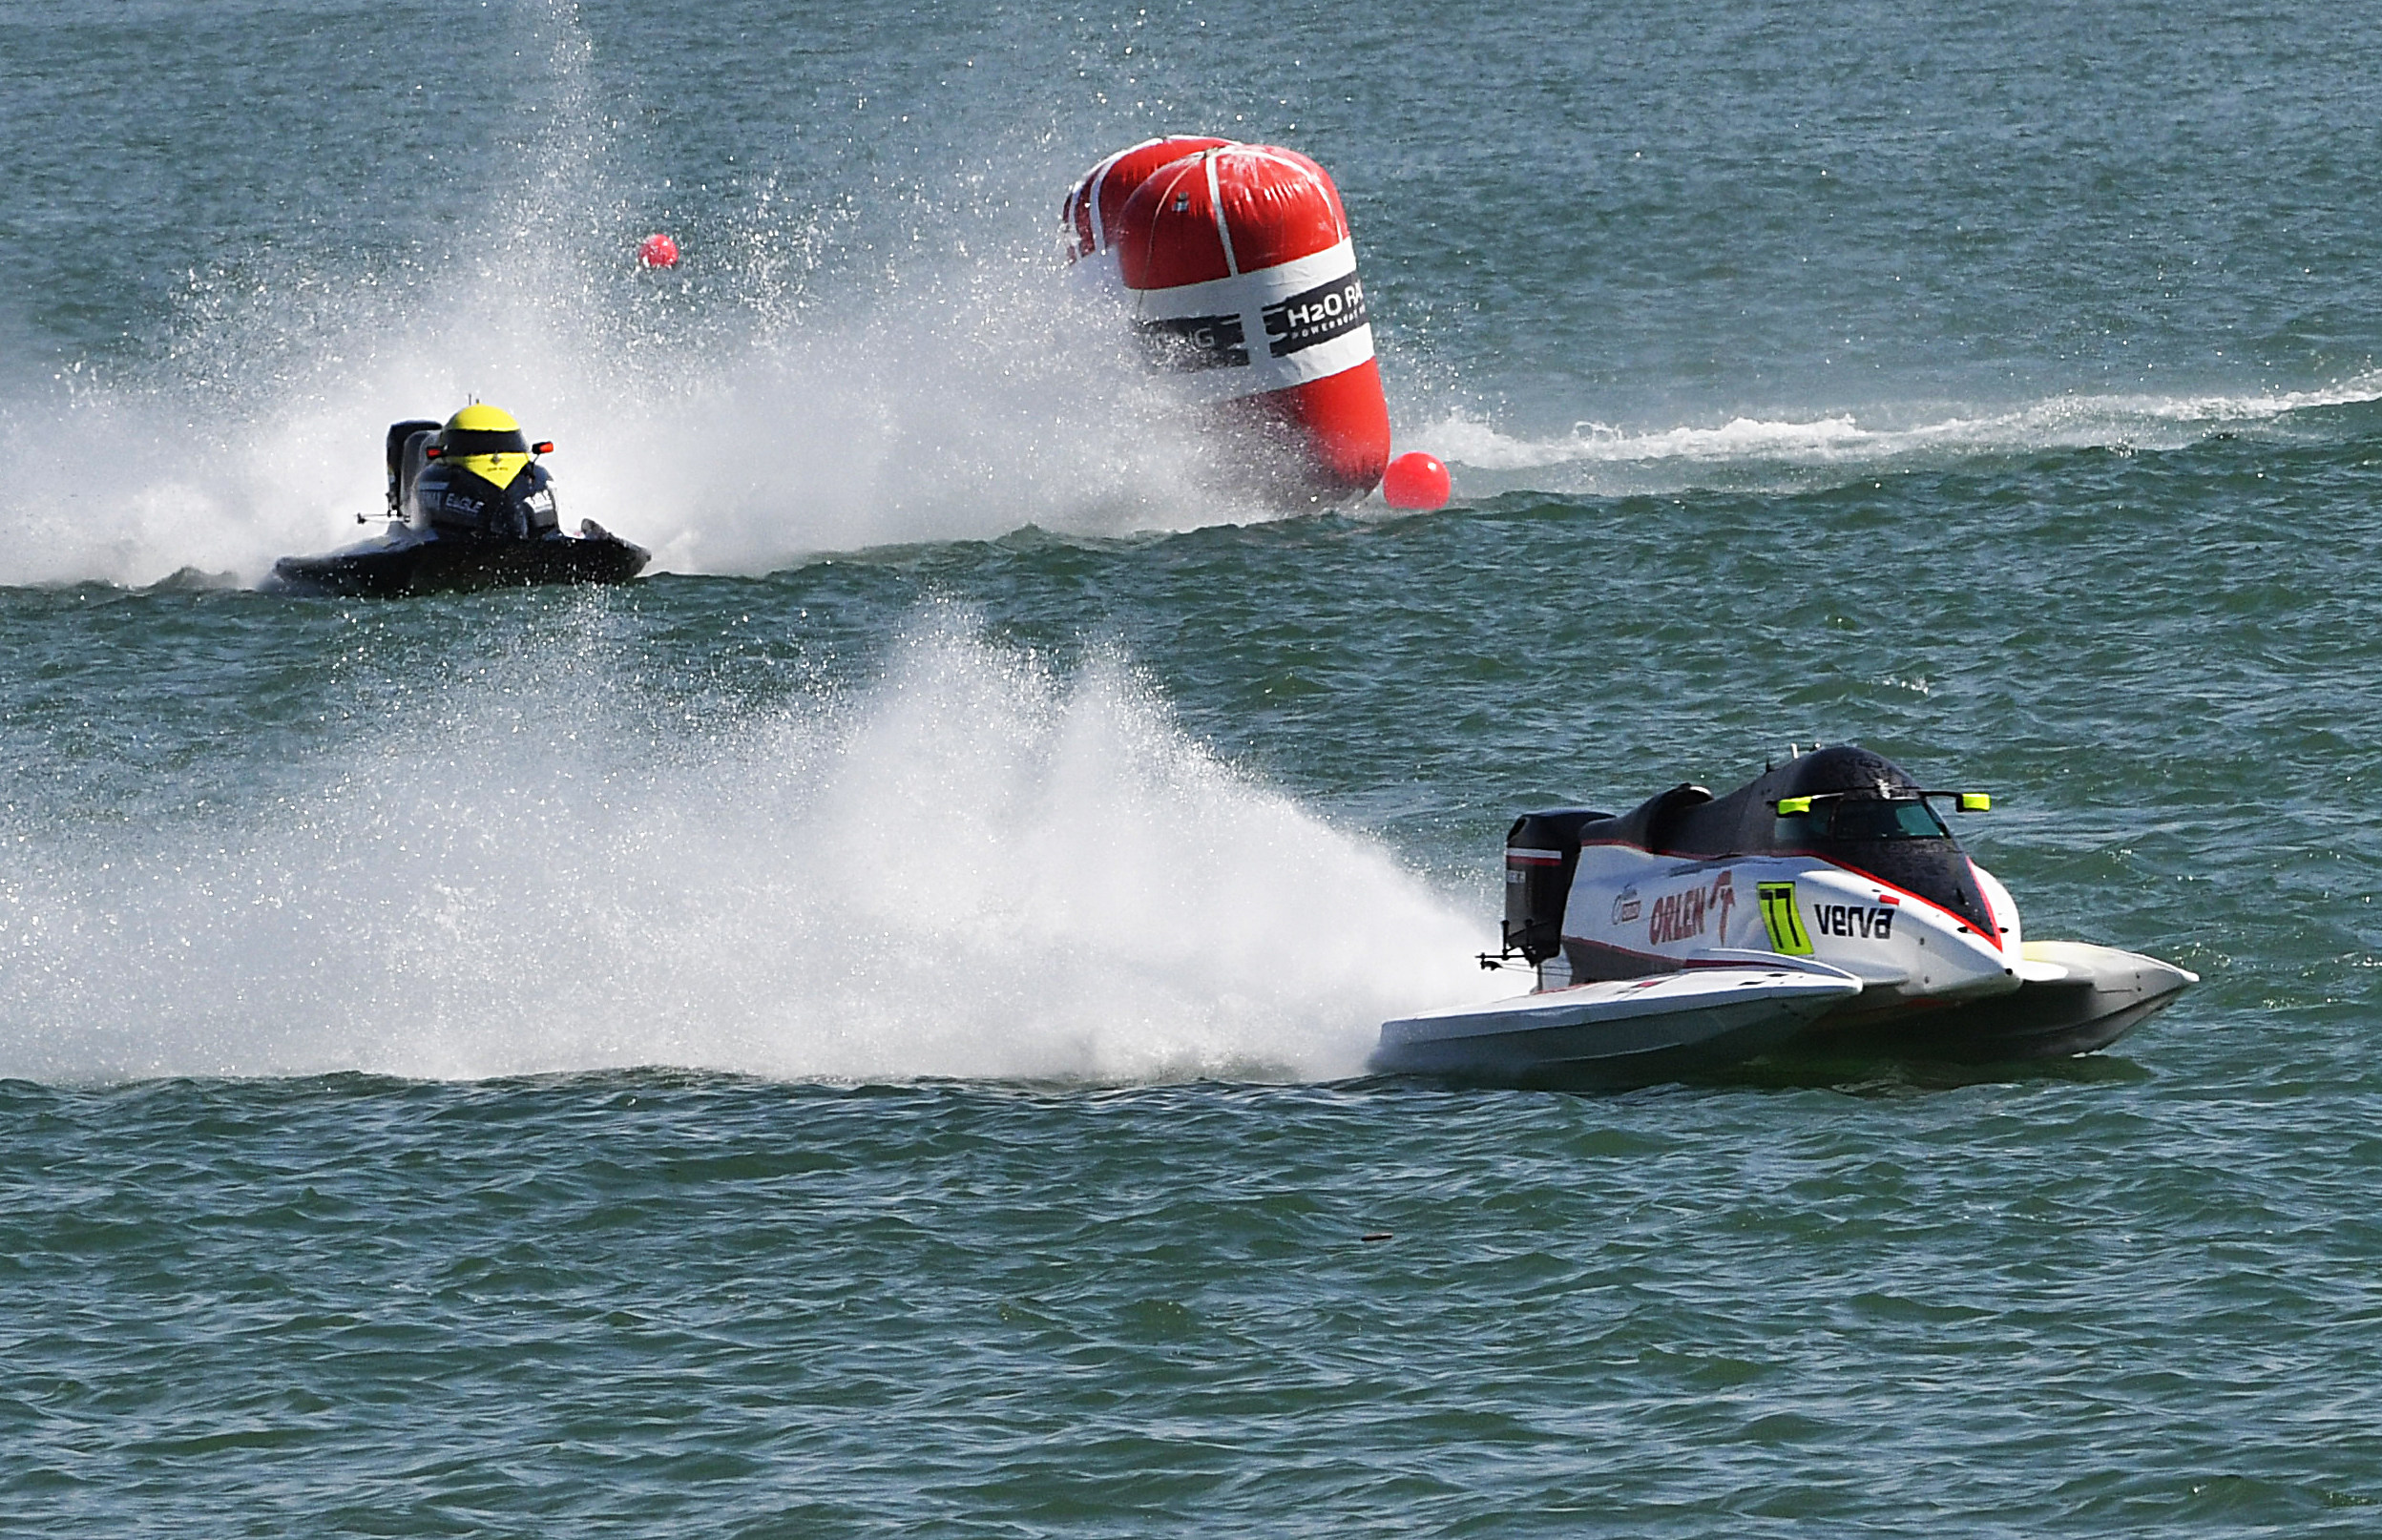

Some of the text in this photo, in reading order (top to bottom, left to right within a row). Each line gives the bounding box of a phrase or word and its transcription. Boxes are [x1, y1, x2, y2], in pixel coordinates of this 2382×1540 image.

[1287, 293, 1343, 327] H2O
[1649, 886, 1706, 946] ORLEN
[1760, 887, 1801, 948] 77
[1814, 905, 1895, 940] verva
